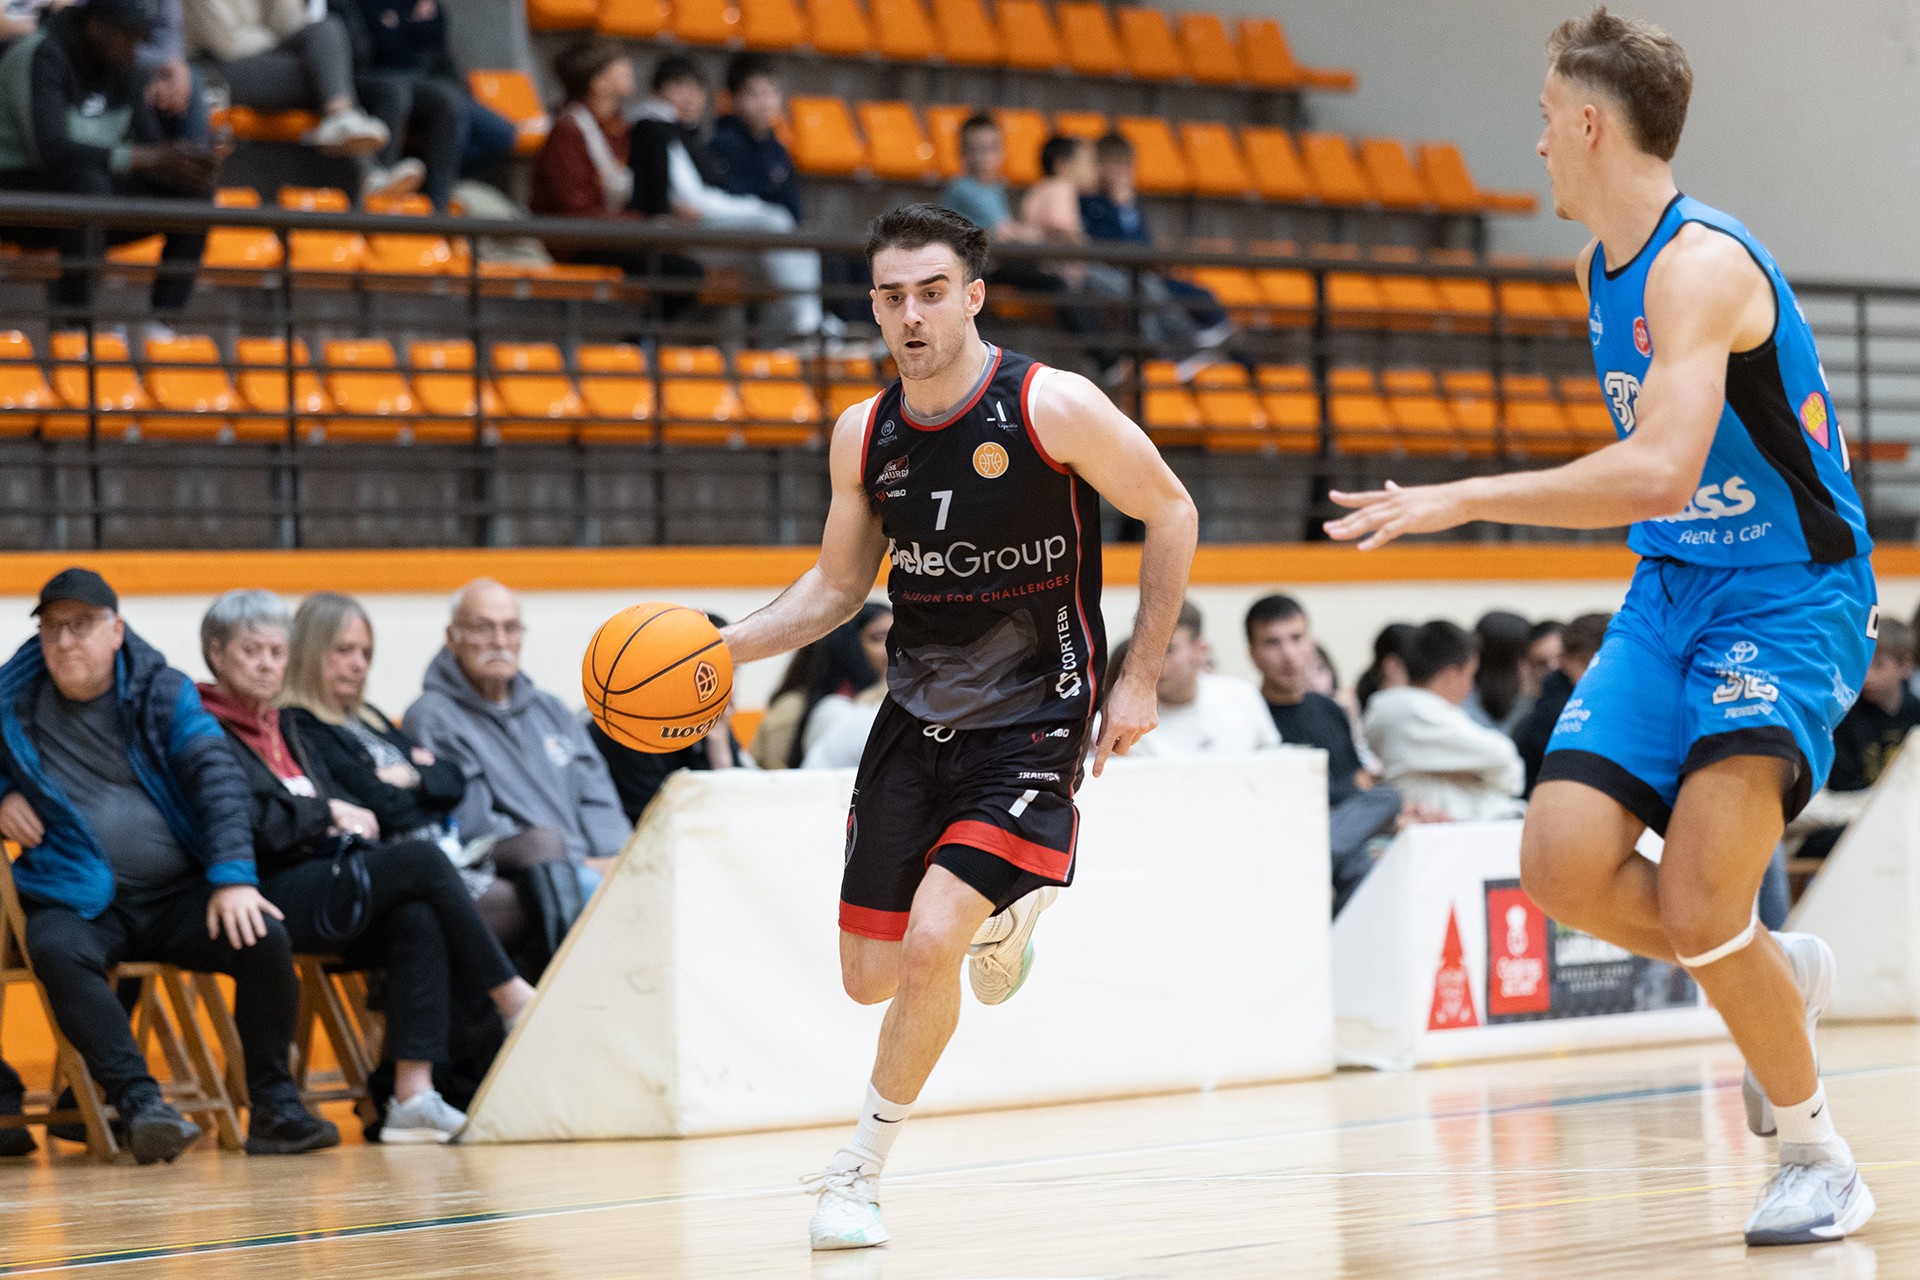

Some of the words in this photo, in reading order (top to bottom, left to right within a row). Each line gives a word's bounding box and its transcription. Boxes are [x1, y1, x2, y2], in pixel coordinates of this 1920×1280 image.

[886, 489, 907, 498] WIBO
[930, 490, 953, 531] 7
[1722, 530, 1734, 545] a
[1739, 521, 1772, 542] car
[981, 574, 1070, 602] CHALLENGES
[1056, 605, 1078, 671] CORTEBI
